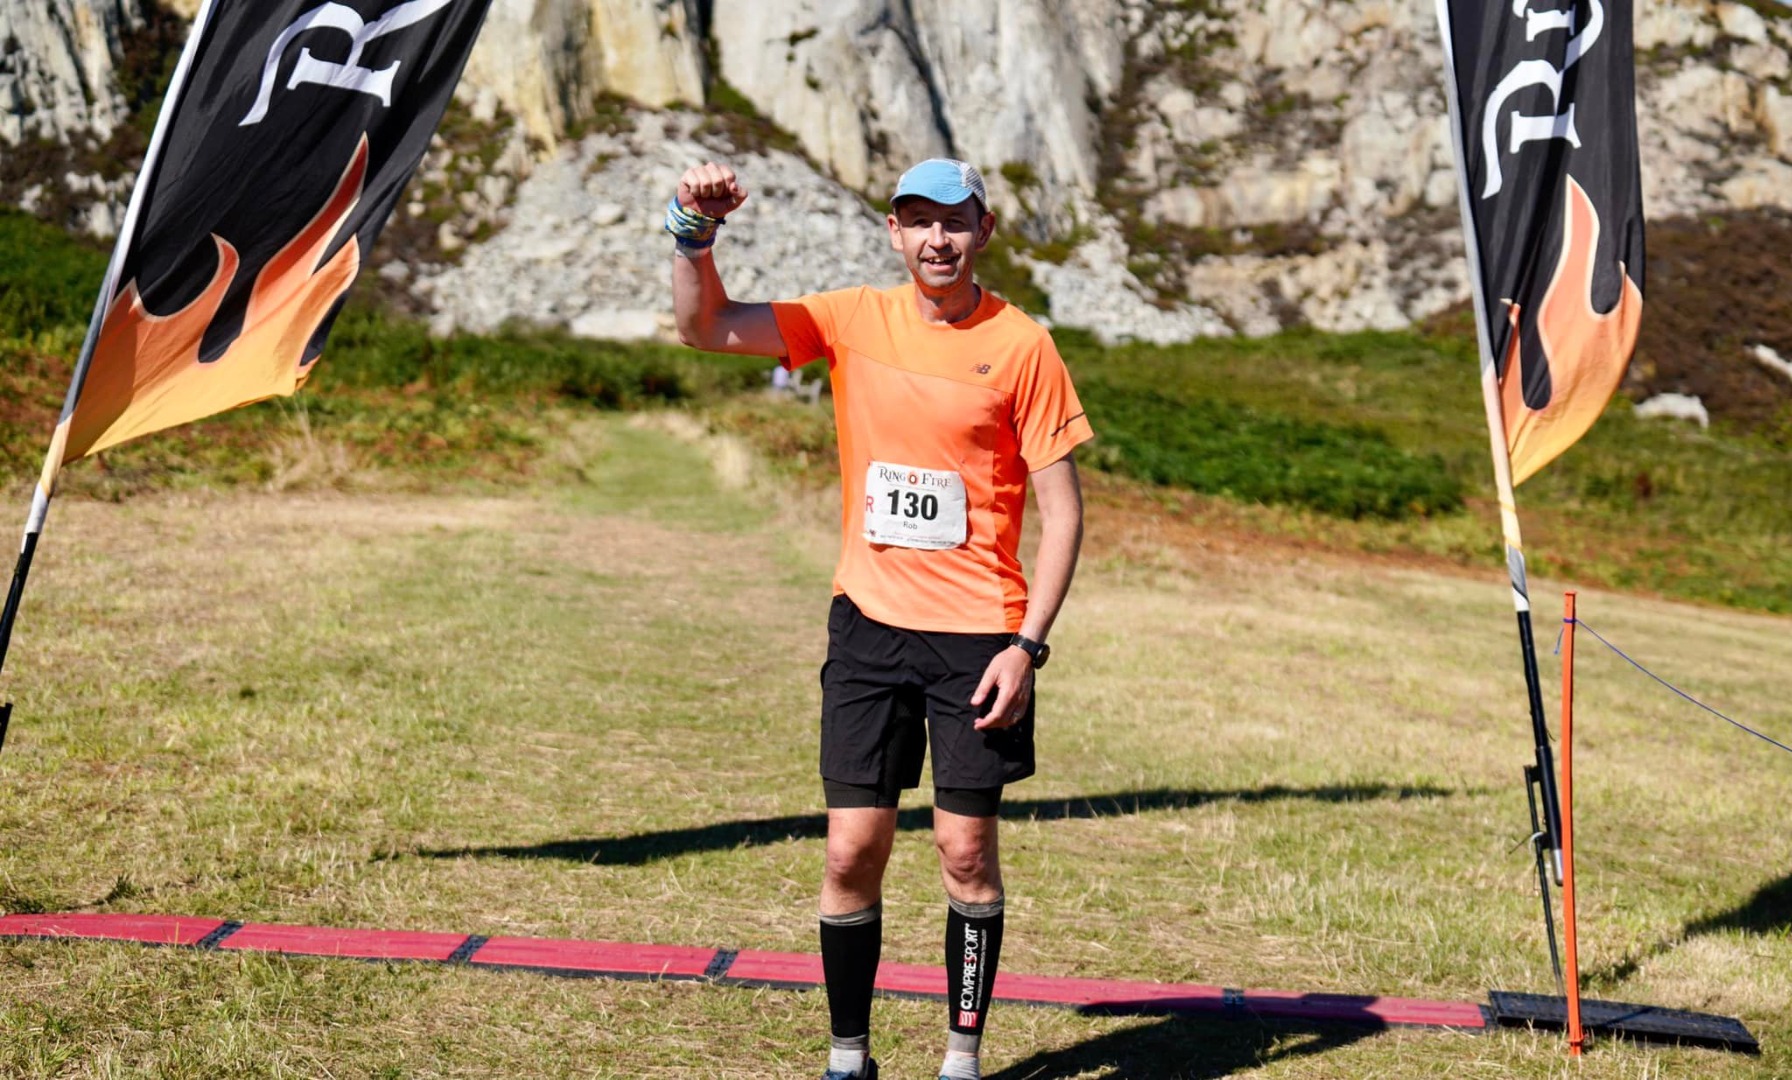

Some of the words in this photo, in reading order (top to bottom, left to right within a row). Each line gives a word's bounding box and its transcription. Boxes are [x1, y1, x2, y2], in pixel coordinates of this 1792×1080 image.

[878, 466, 906, 482] RING
[921, 472, 952, 488] FIRE
[887, 489, 938, 521] 130
[903, 521, 918, 530] Rob
